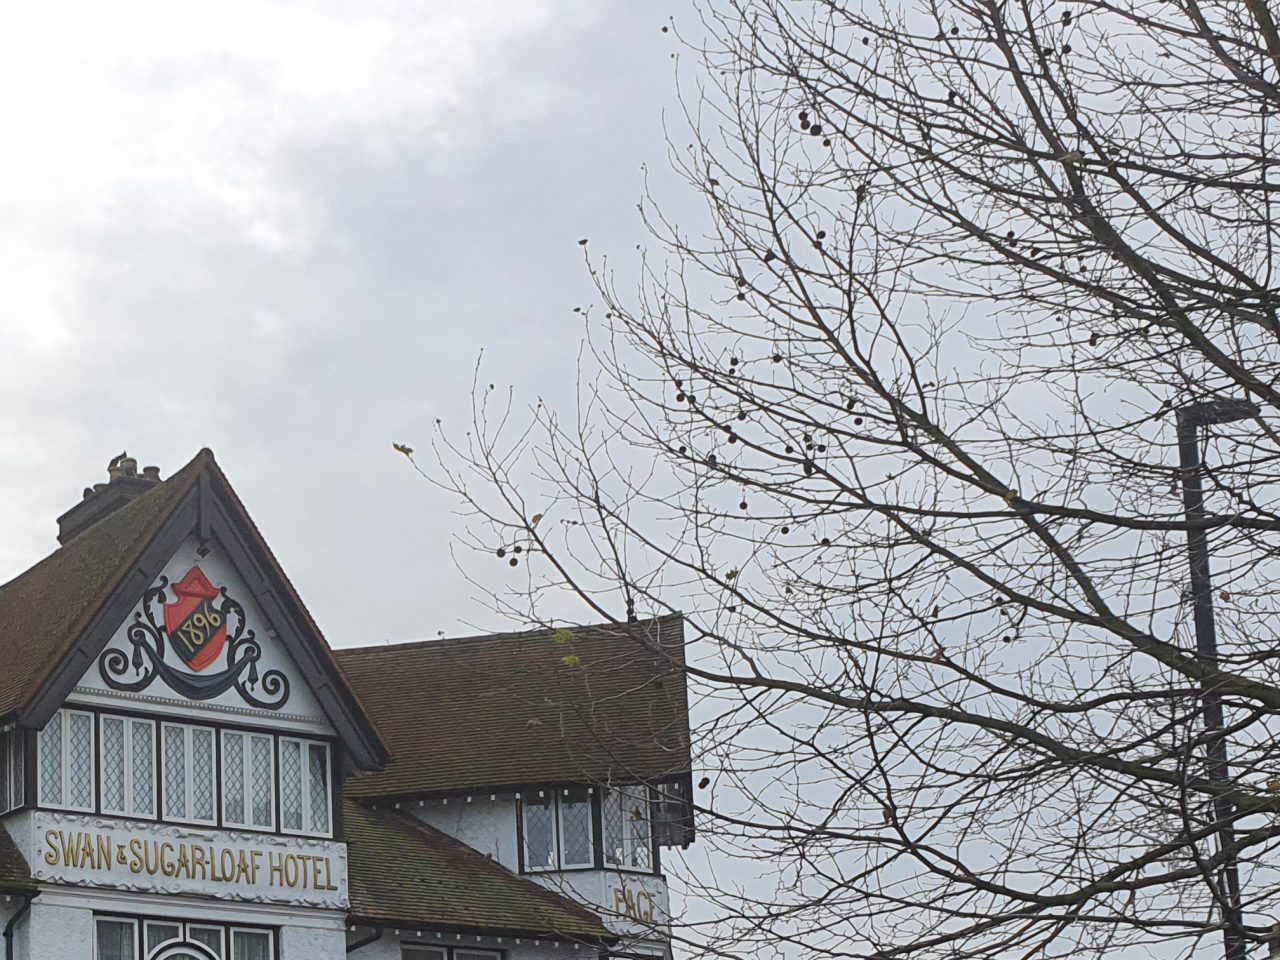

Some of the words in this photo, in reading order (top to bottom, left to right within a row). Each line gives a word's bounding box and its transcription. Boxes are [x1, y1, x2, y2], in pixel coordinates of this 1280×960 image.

[177, 602, 221, 653] 1896
[44, 829, 112, 871] SWAN
[116, 844, 128, 865] &
[268, 851, 339, 891] HOTEL
